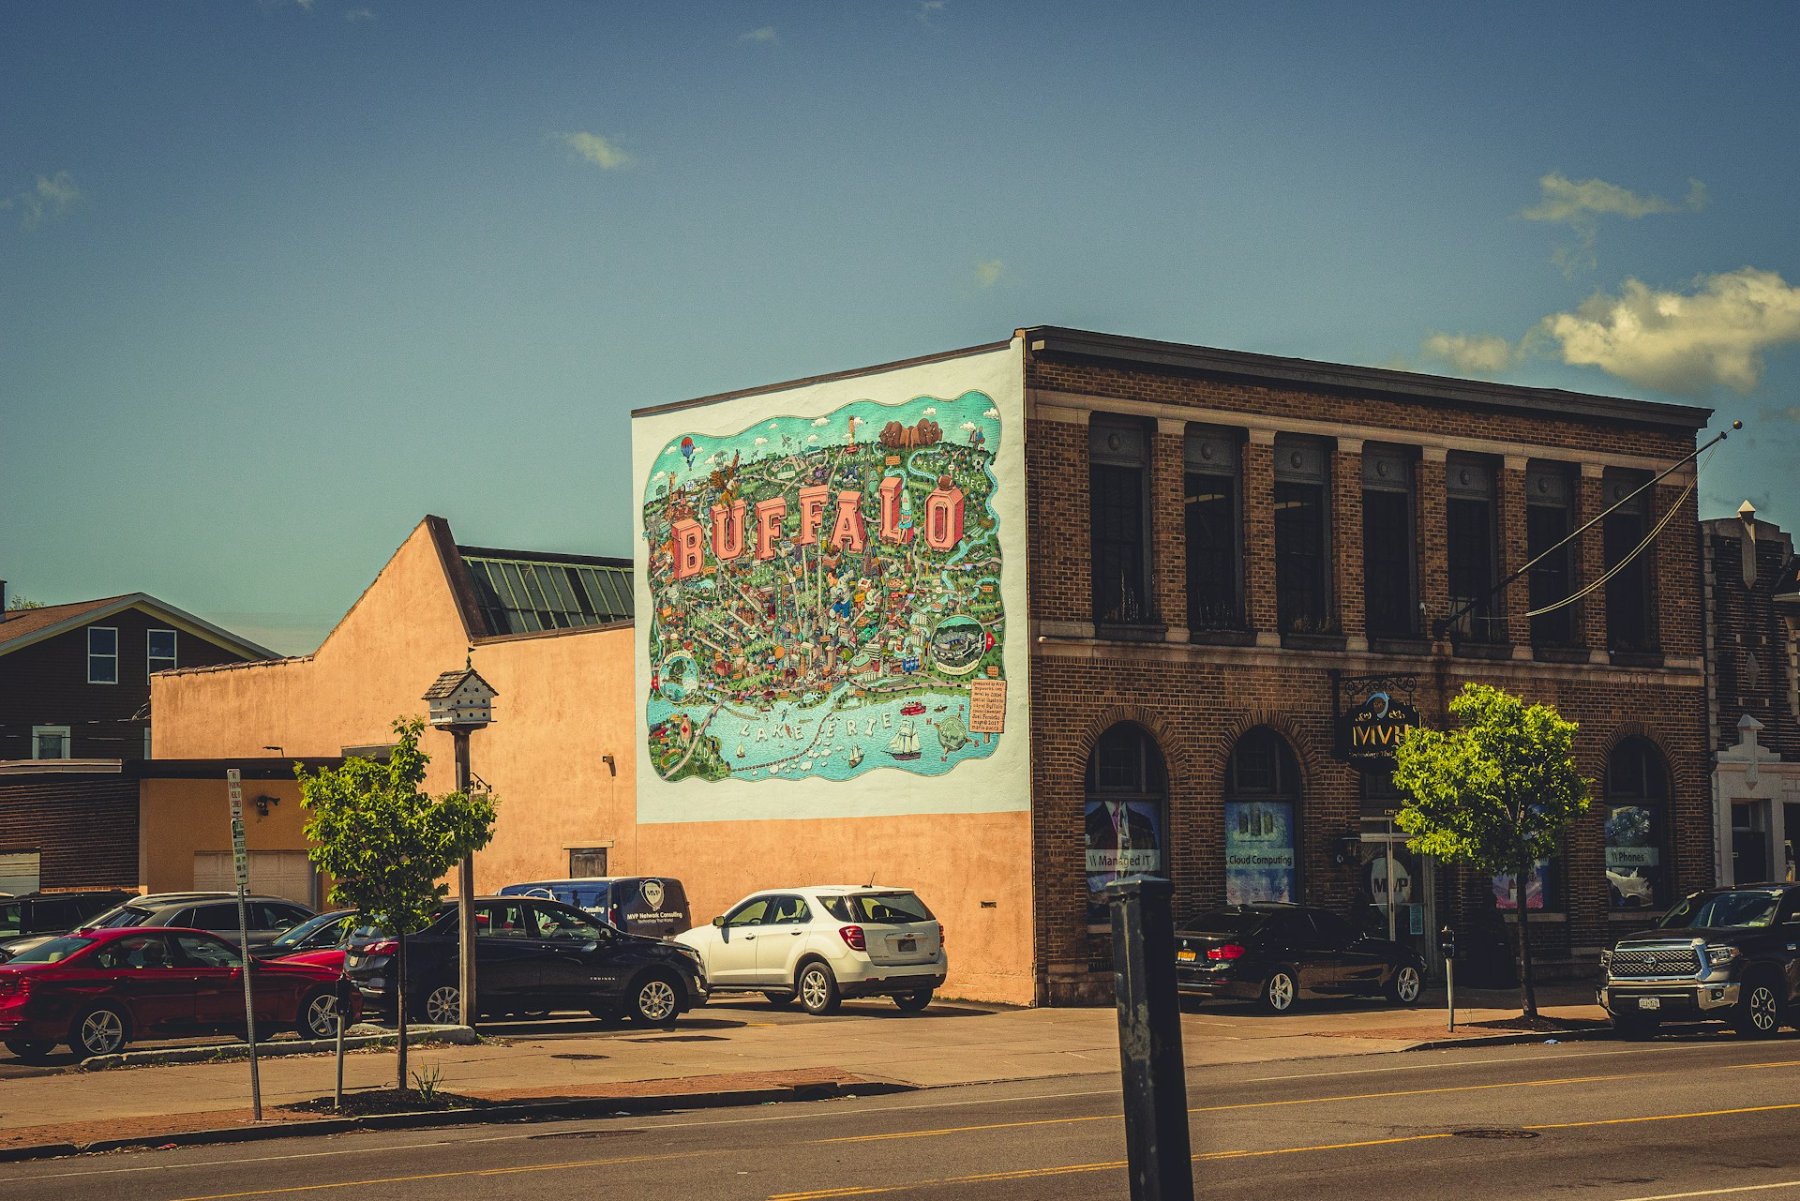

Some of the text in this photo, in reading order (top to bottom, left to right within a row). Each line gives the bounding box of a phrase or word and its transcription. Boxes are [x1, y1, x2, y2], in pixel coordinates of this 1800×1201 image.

[671, 477, 965, 580] BUFFALO
[740, 712, 893, 743] LAKE ERIE
[1099, 854, 1151, 869] Managed IT
[1229, 854, 1292, 868] Cloud Computing
[1618, 851, 1645, 862] Phones
[660, 911, 683, 919] Consulting
